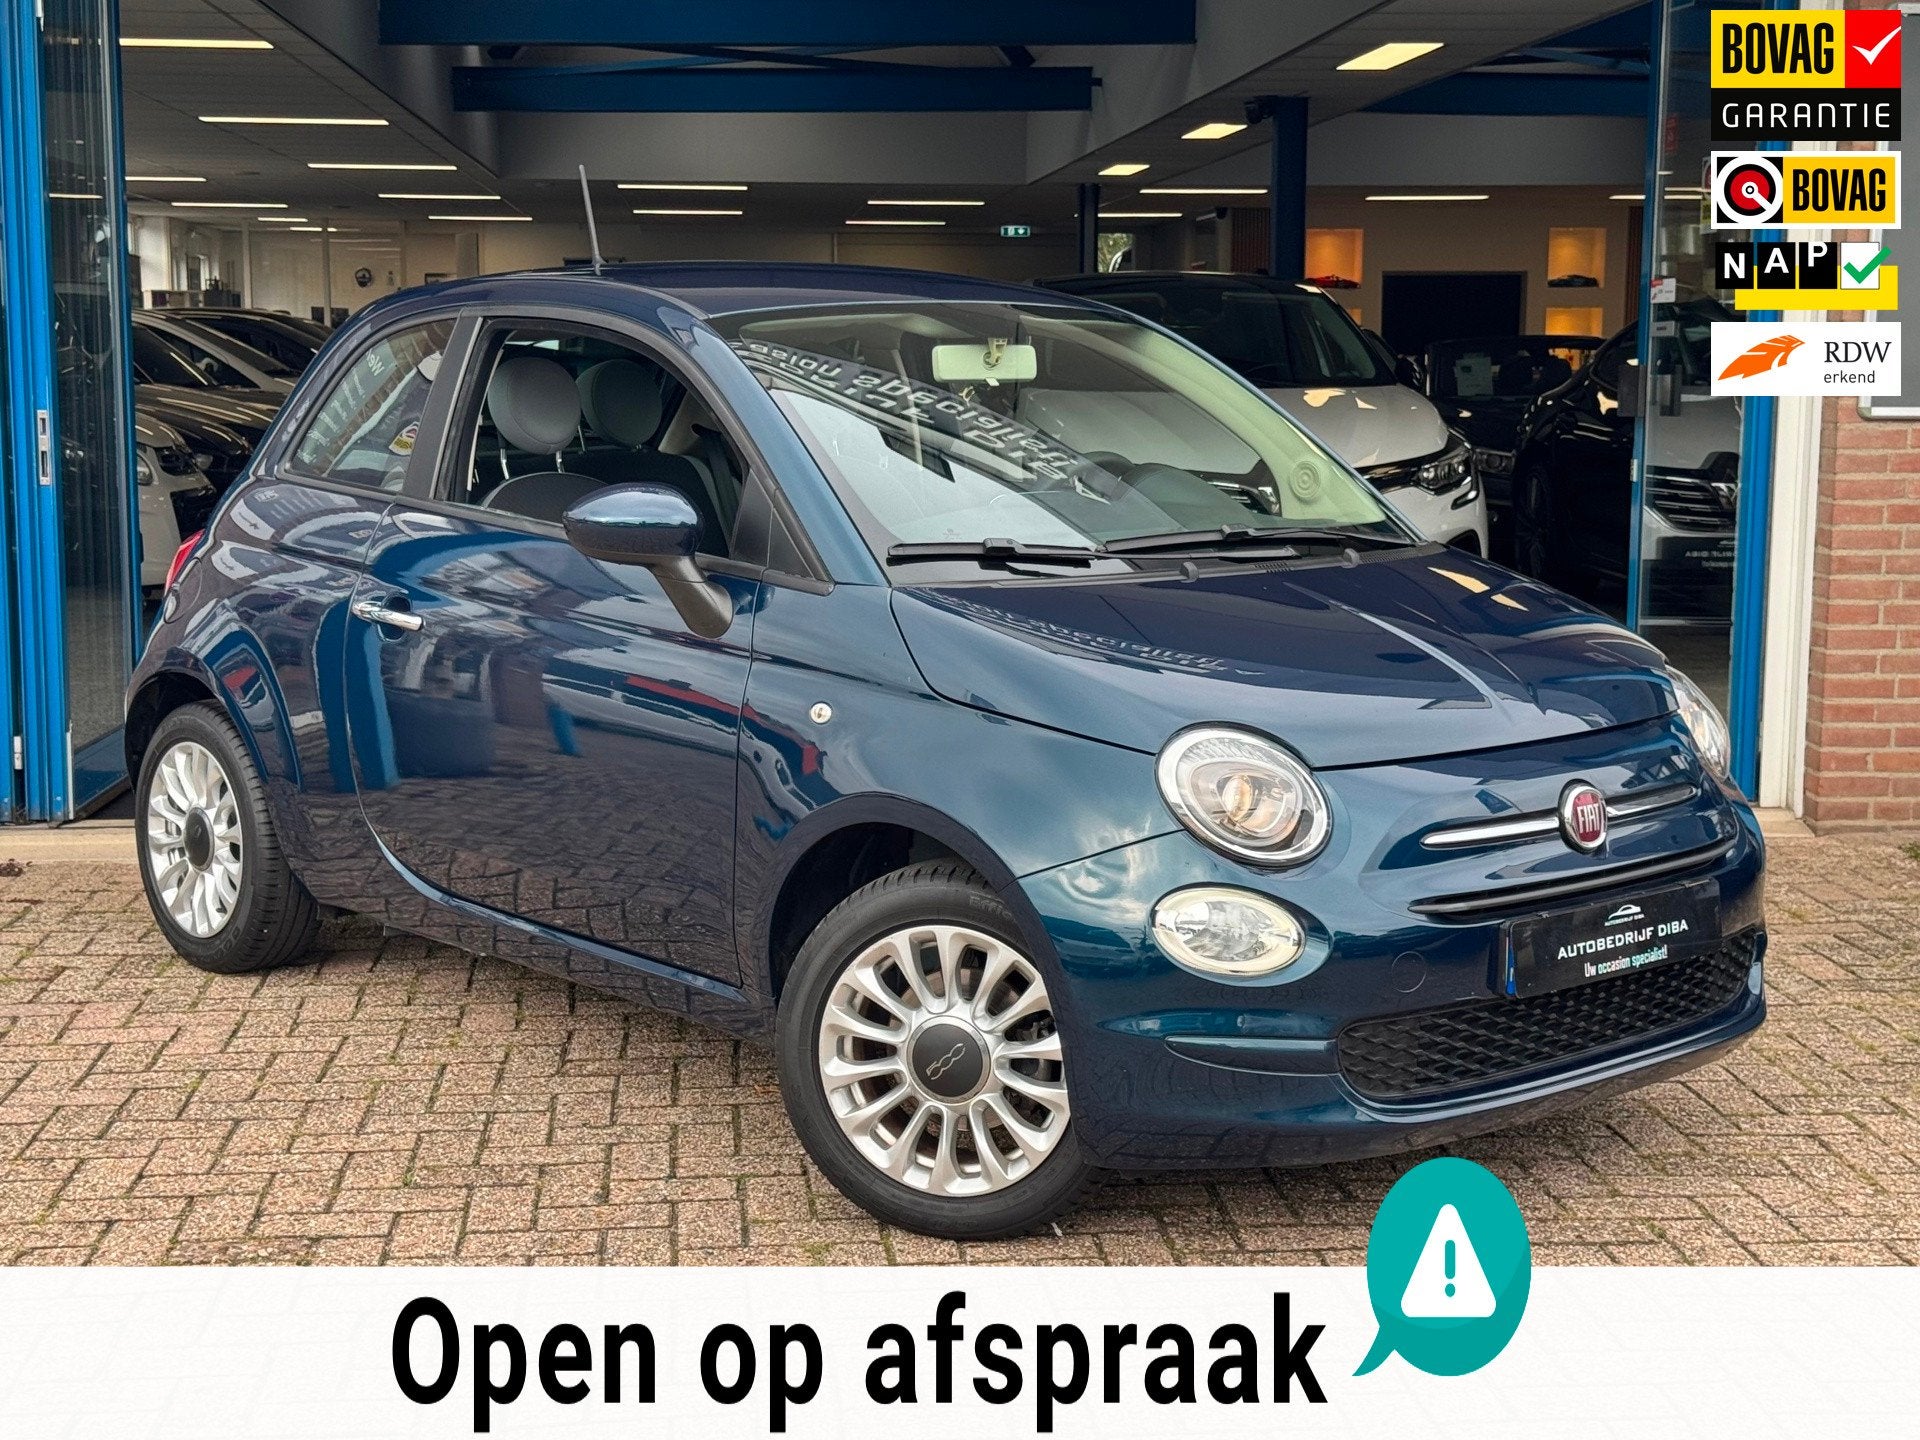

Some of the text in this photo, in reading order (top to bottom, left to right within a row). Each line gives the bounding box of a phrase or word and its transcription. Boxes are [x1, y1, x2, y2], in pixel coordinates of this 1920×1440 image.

[1577, 803, 1601, 834] FIAT
[1557, 919, 1689, 960] AUTOBEDRIJF DIBA
[1584, 944, 1668, 977] Uw occasion specialist!
